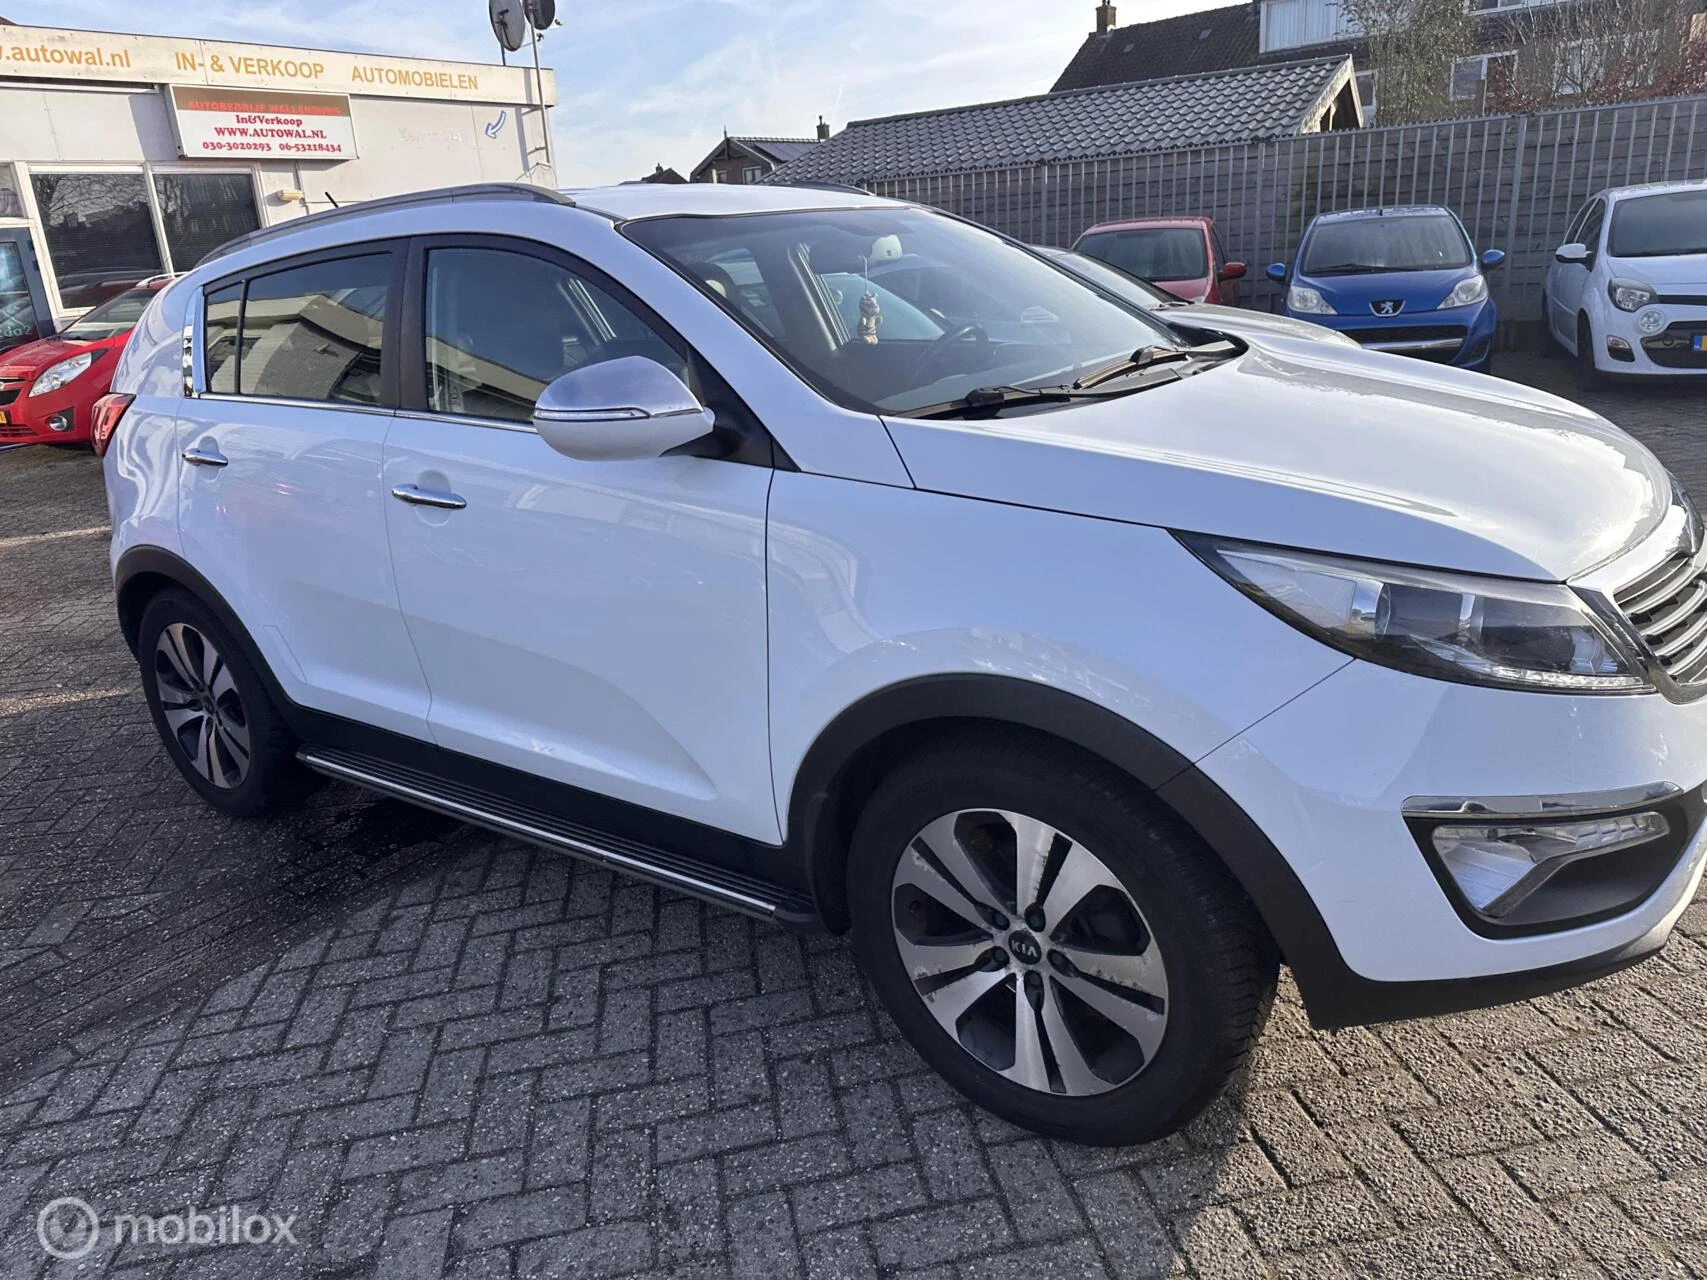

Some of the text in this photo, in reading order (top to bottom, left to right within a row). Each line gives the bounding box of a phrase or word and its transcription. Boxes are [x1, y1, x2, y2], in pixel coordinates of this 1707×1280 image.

[0, 44, 131, 67] .autowal.nl
[175, 52, 478, 90] IN- & VERKOOP AUTOMOBIELEN
[235, 114, 303, 127] In&Verkoop
[214, 127, 327, 139] WWW.AUTOWAL.NL
[202, 141, 342, 153] 030-3020293 06-53218434
[1011, 940, 1037, 957] KIA
